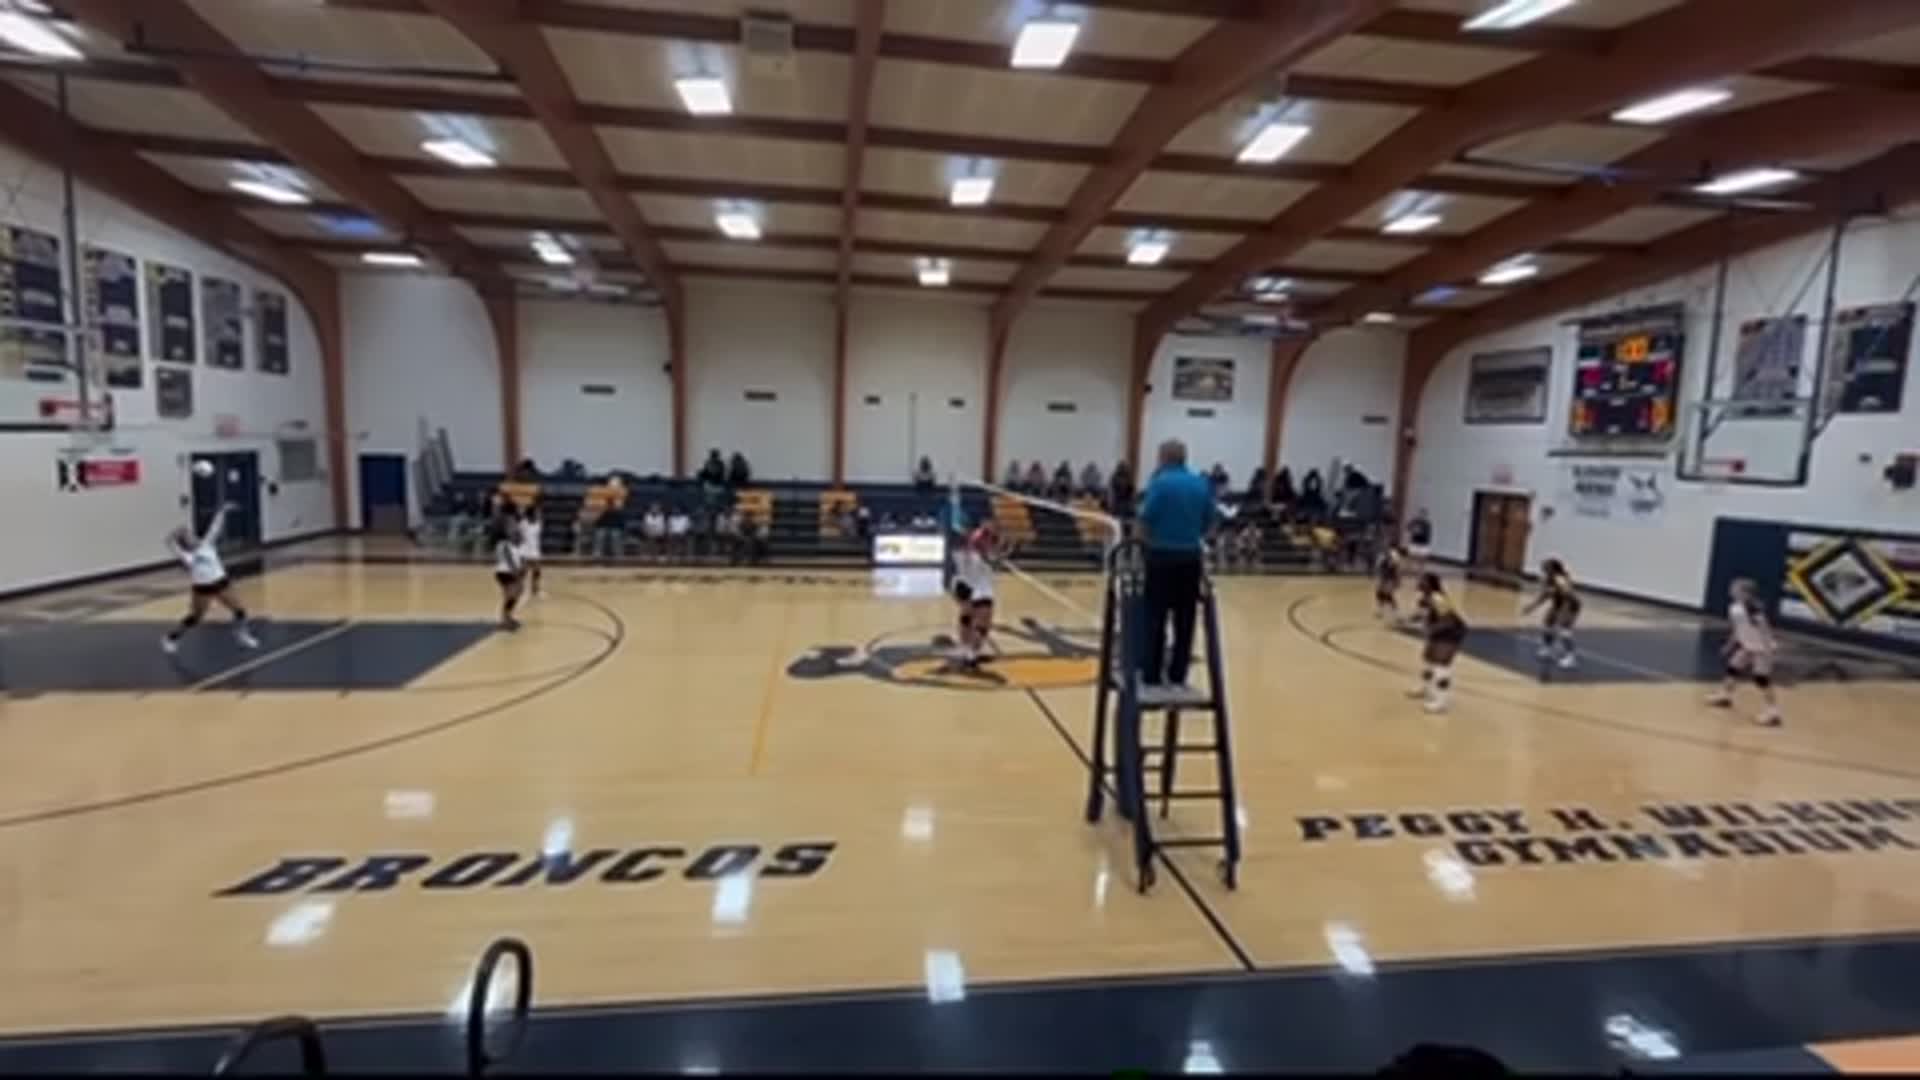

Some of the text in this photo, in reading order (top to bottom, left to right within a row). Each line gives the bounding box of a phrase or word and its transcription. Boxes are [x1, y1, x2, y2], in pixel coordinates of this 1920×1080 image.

[1296, 811, 1530, 841] PEGGY
[1546, 806, 1633, 832] H.
[1453, 826, 1919, 866] GYMNASIUM
[212, 842, 837, 899] BRONCOS
